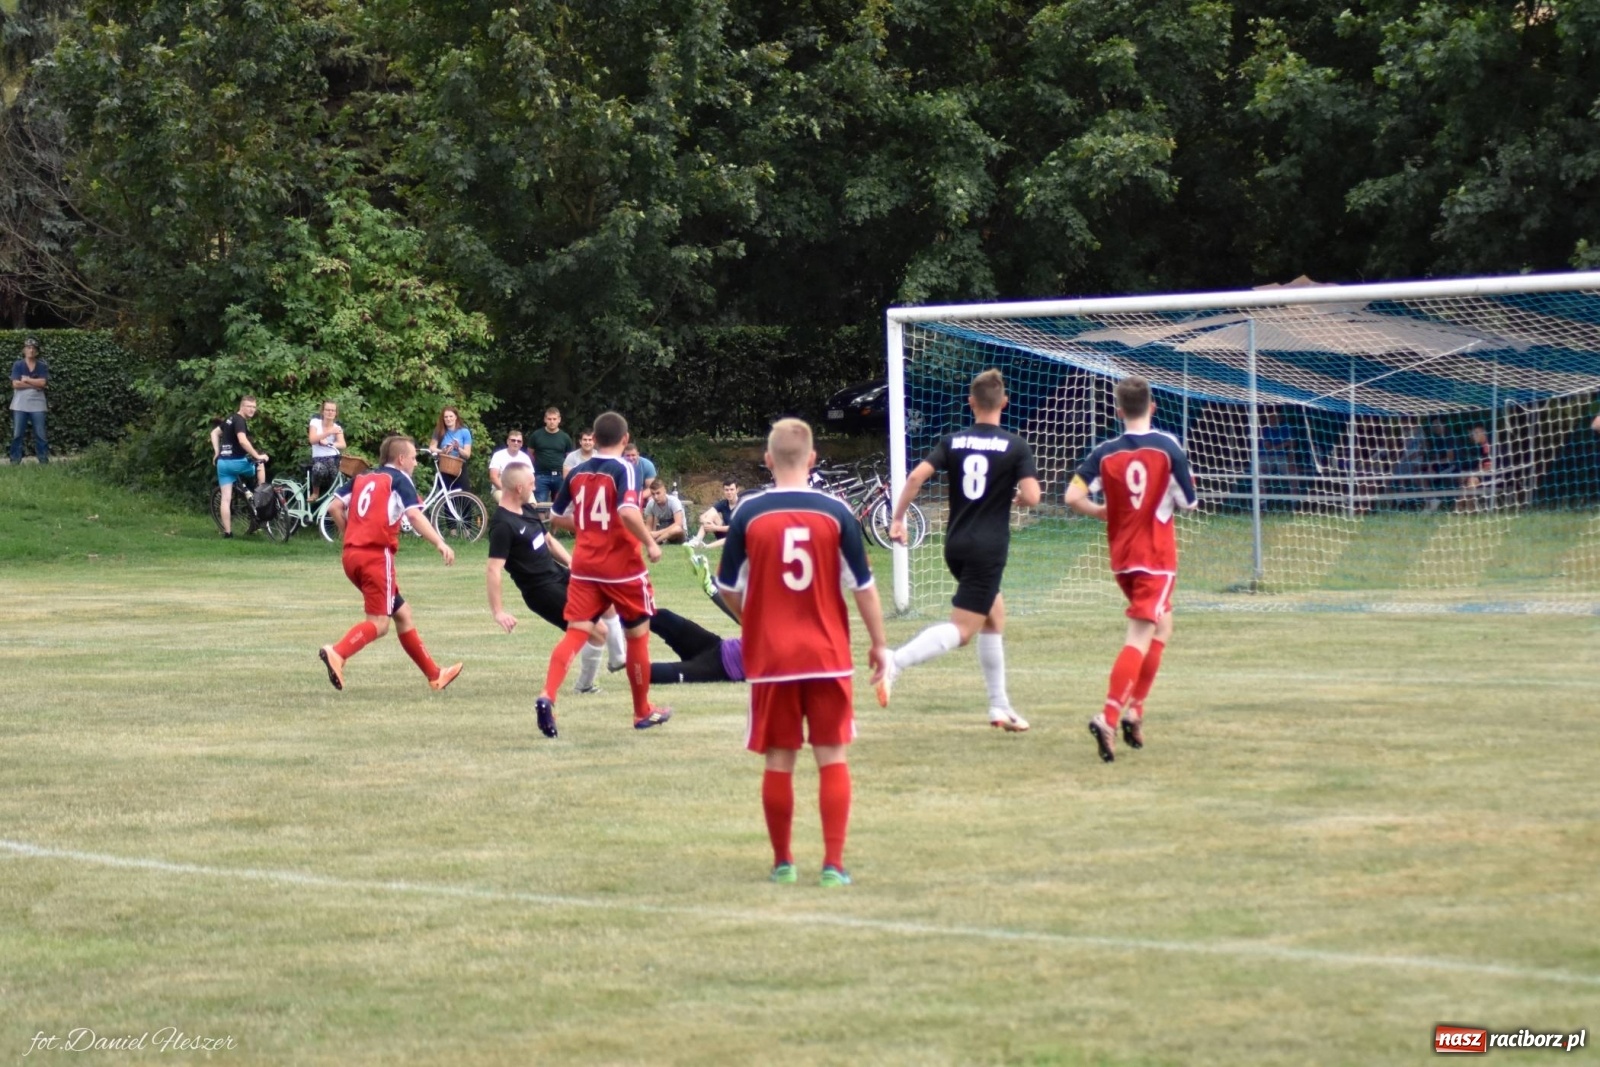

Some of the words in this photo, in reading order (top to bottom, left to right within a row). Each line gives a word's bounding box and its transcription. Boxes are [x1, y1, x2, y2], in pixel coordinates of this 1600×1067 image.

[357, 481, 376, 518] 6
[962, 454, 989, 500] 8
[1126, 460, 1147, 510] 9
[575, 485, 611, 531] 14
[782, 527, 814, 591] 5
